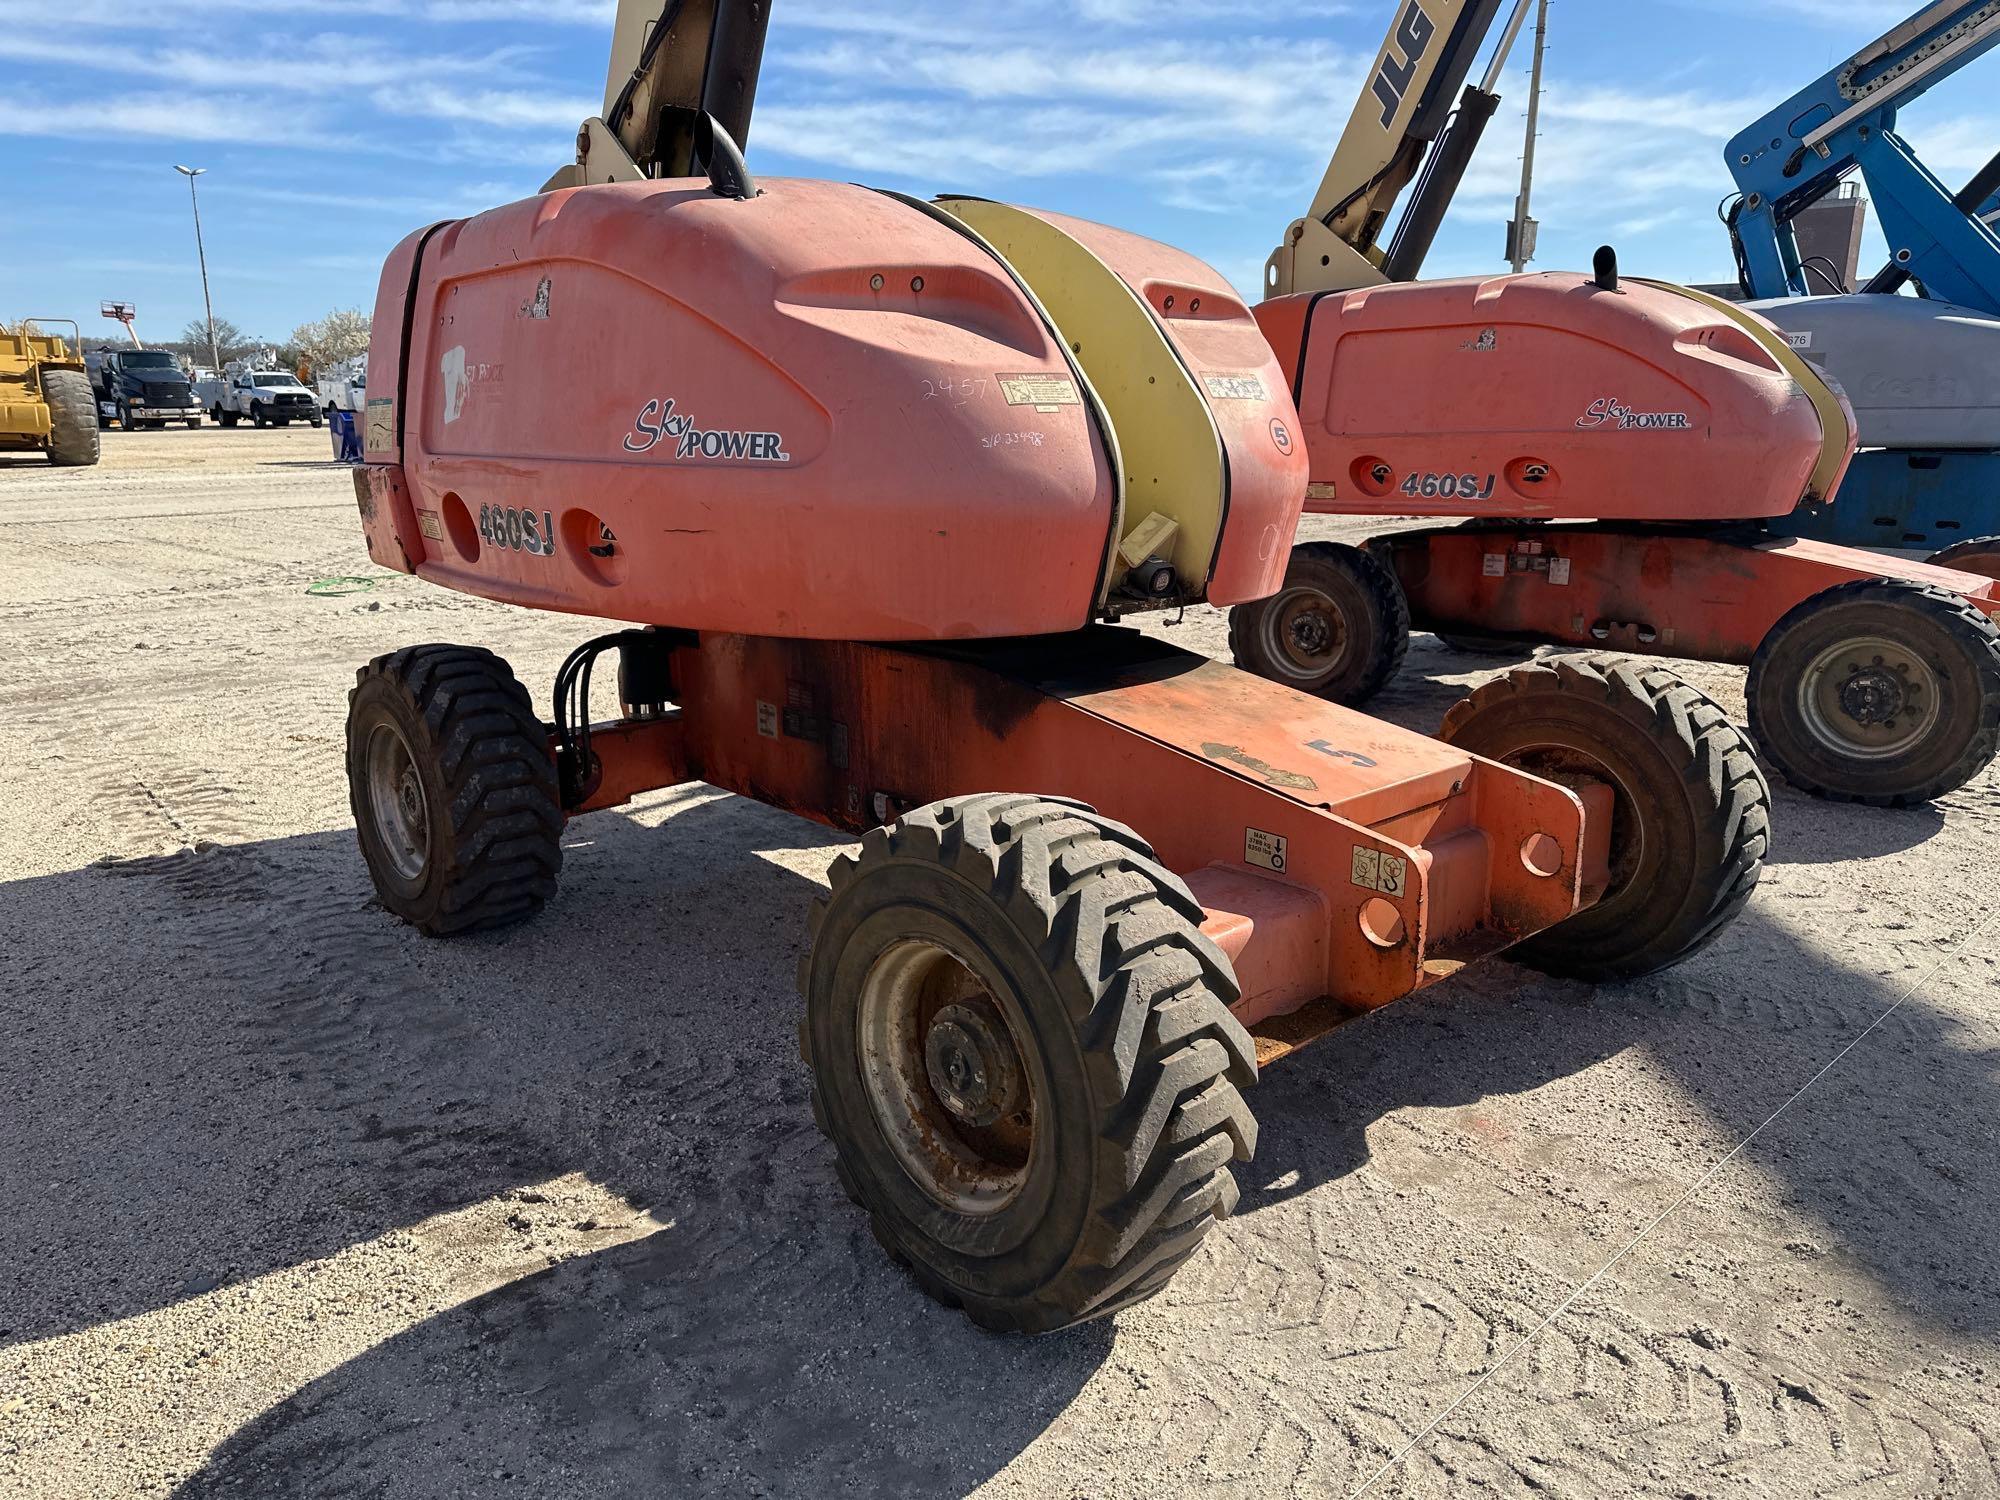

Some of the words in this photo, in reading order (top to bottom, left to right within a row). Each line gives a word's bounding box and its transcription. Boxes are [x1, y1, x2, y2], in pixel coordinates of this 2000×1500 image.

[1371, 0, 1437, 133] JLG
[920, 376, 987, 401] 2457
[1274, 426, 1289, 447] 5
[1400, 472, 1496, 499] 460SJ
[479, 502, 556, 556] 460SJ
[1306, 739, 1378, 768] 5
[1253, 831, 1267, 841] MAX
